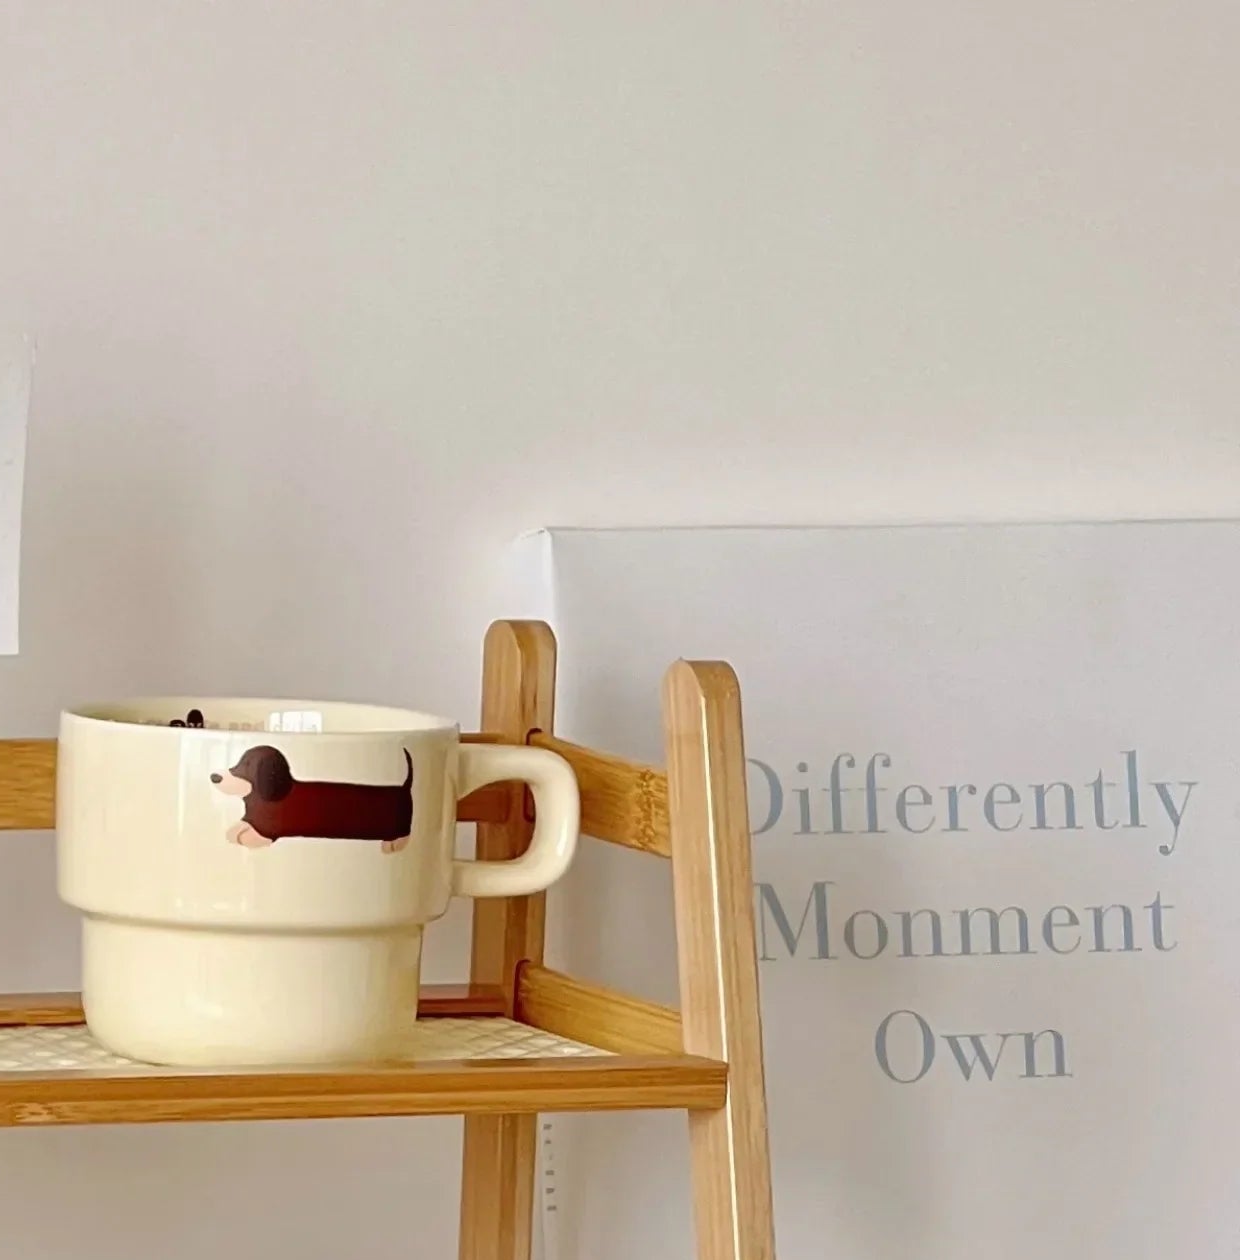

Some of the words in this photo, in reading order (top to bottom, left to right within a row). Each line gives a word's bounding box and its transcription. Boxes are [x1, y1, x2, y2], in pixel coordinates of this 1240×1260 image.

[746, 751, 1199, 856] Differently
[753, 880, 1179, 962] Monment
[874, 1010, 1075, 1085] Own
